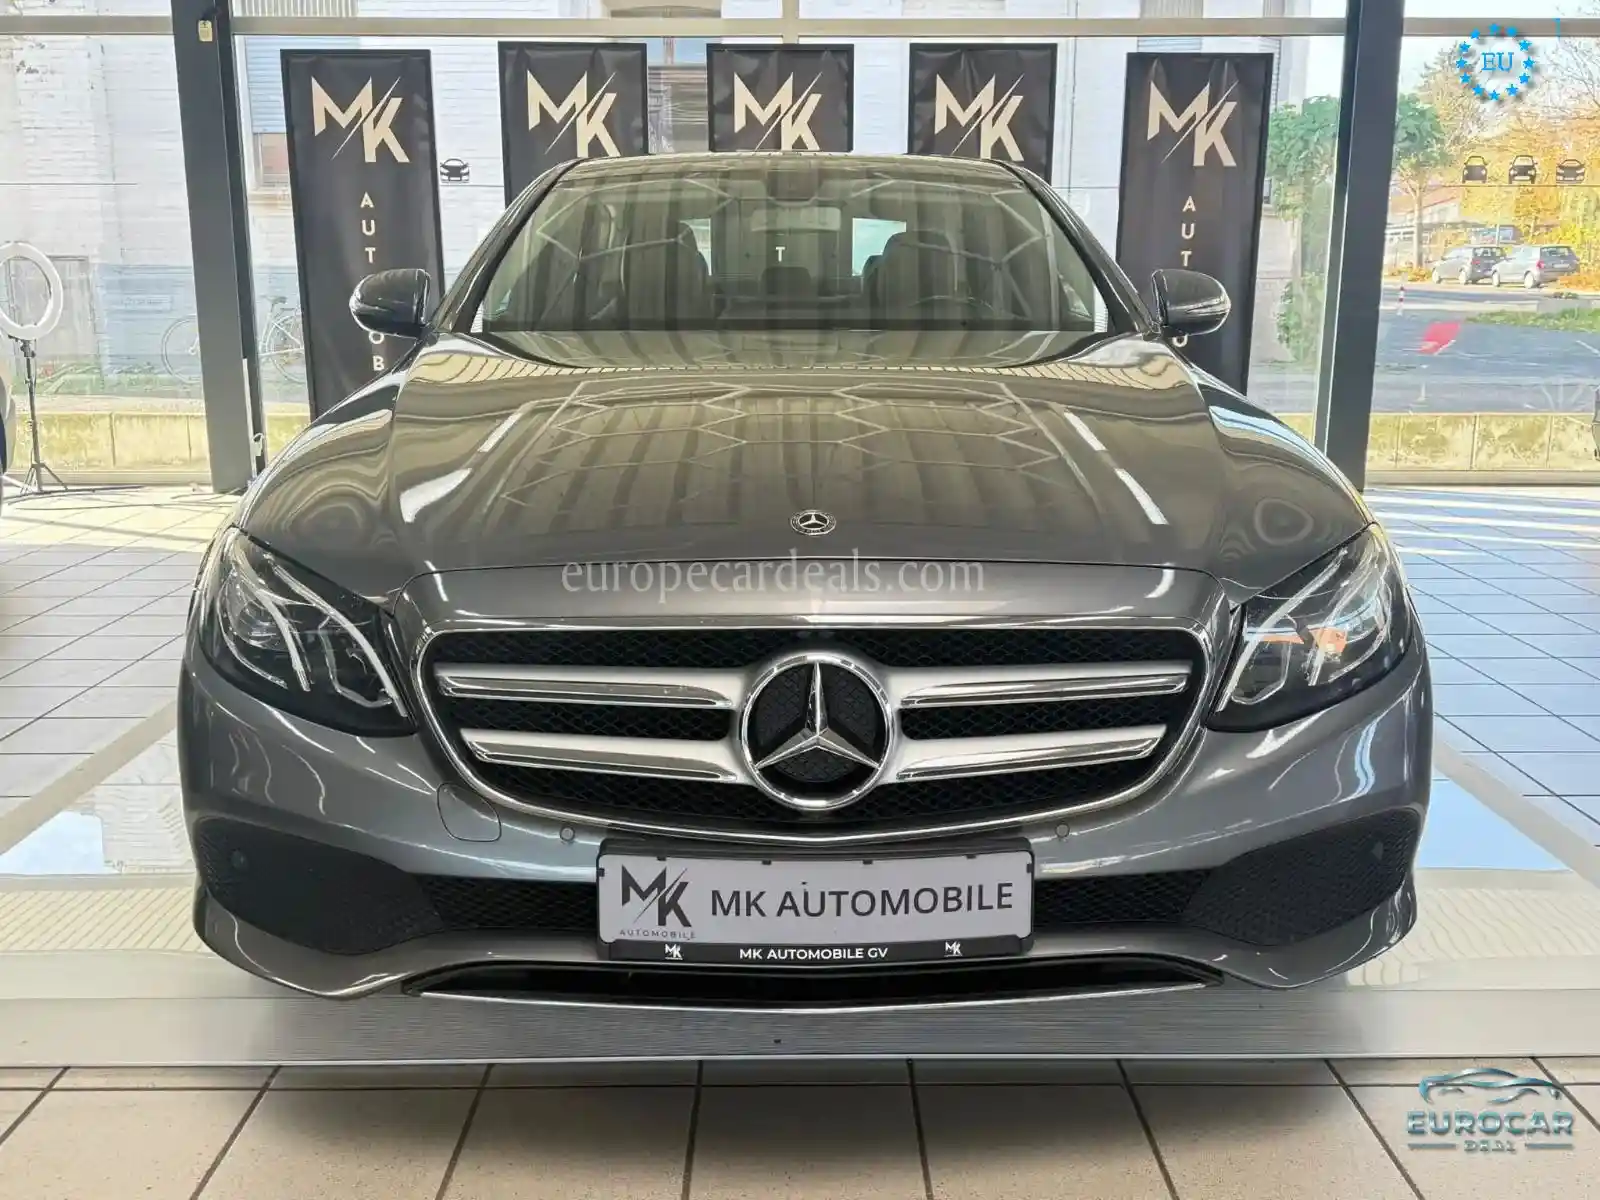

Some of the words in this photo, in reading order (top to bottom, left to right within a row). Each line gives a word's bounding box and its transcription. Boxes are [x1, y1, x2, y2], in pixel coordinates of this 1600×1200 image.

[311, 76, 410, 163] MK
[527, 70, 621, 157] MK
[934, 73, 1025, 161] MK
[1147, 79, 1239, 166] MK
[621, 864, 692, 927] MK
[711, 889, 766, 917] MK
[776, 883, 1013, 917] AUTOMOBILE
[619, 929, 696, 939] AUTOMOBILE
[739, 949, 764, 960] MK
[767, 947, 863, 960] AUTOMOBILE
[868, 947, 889, 959] GV
